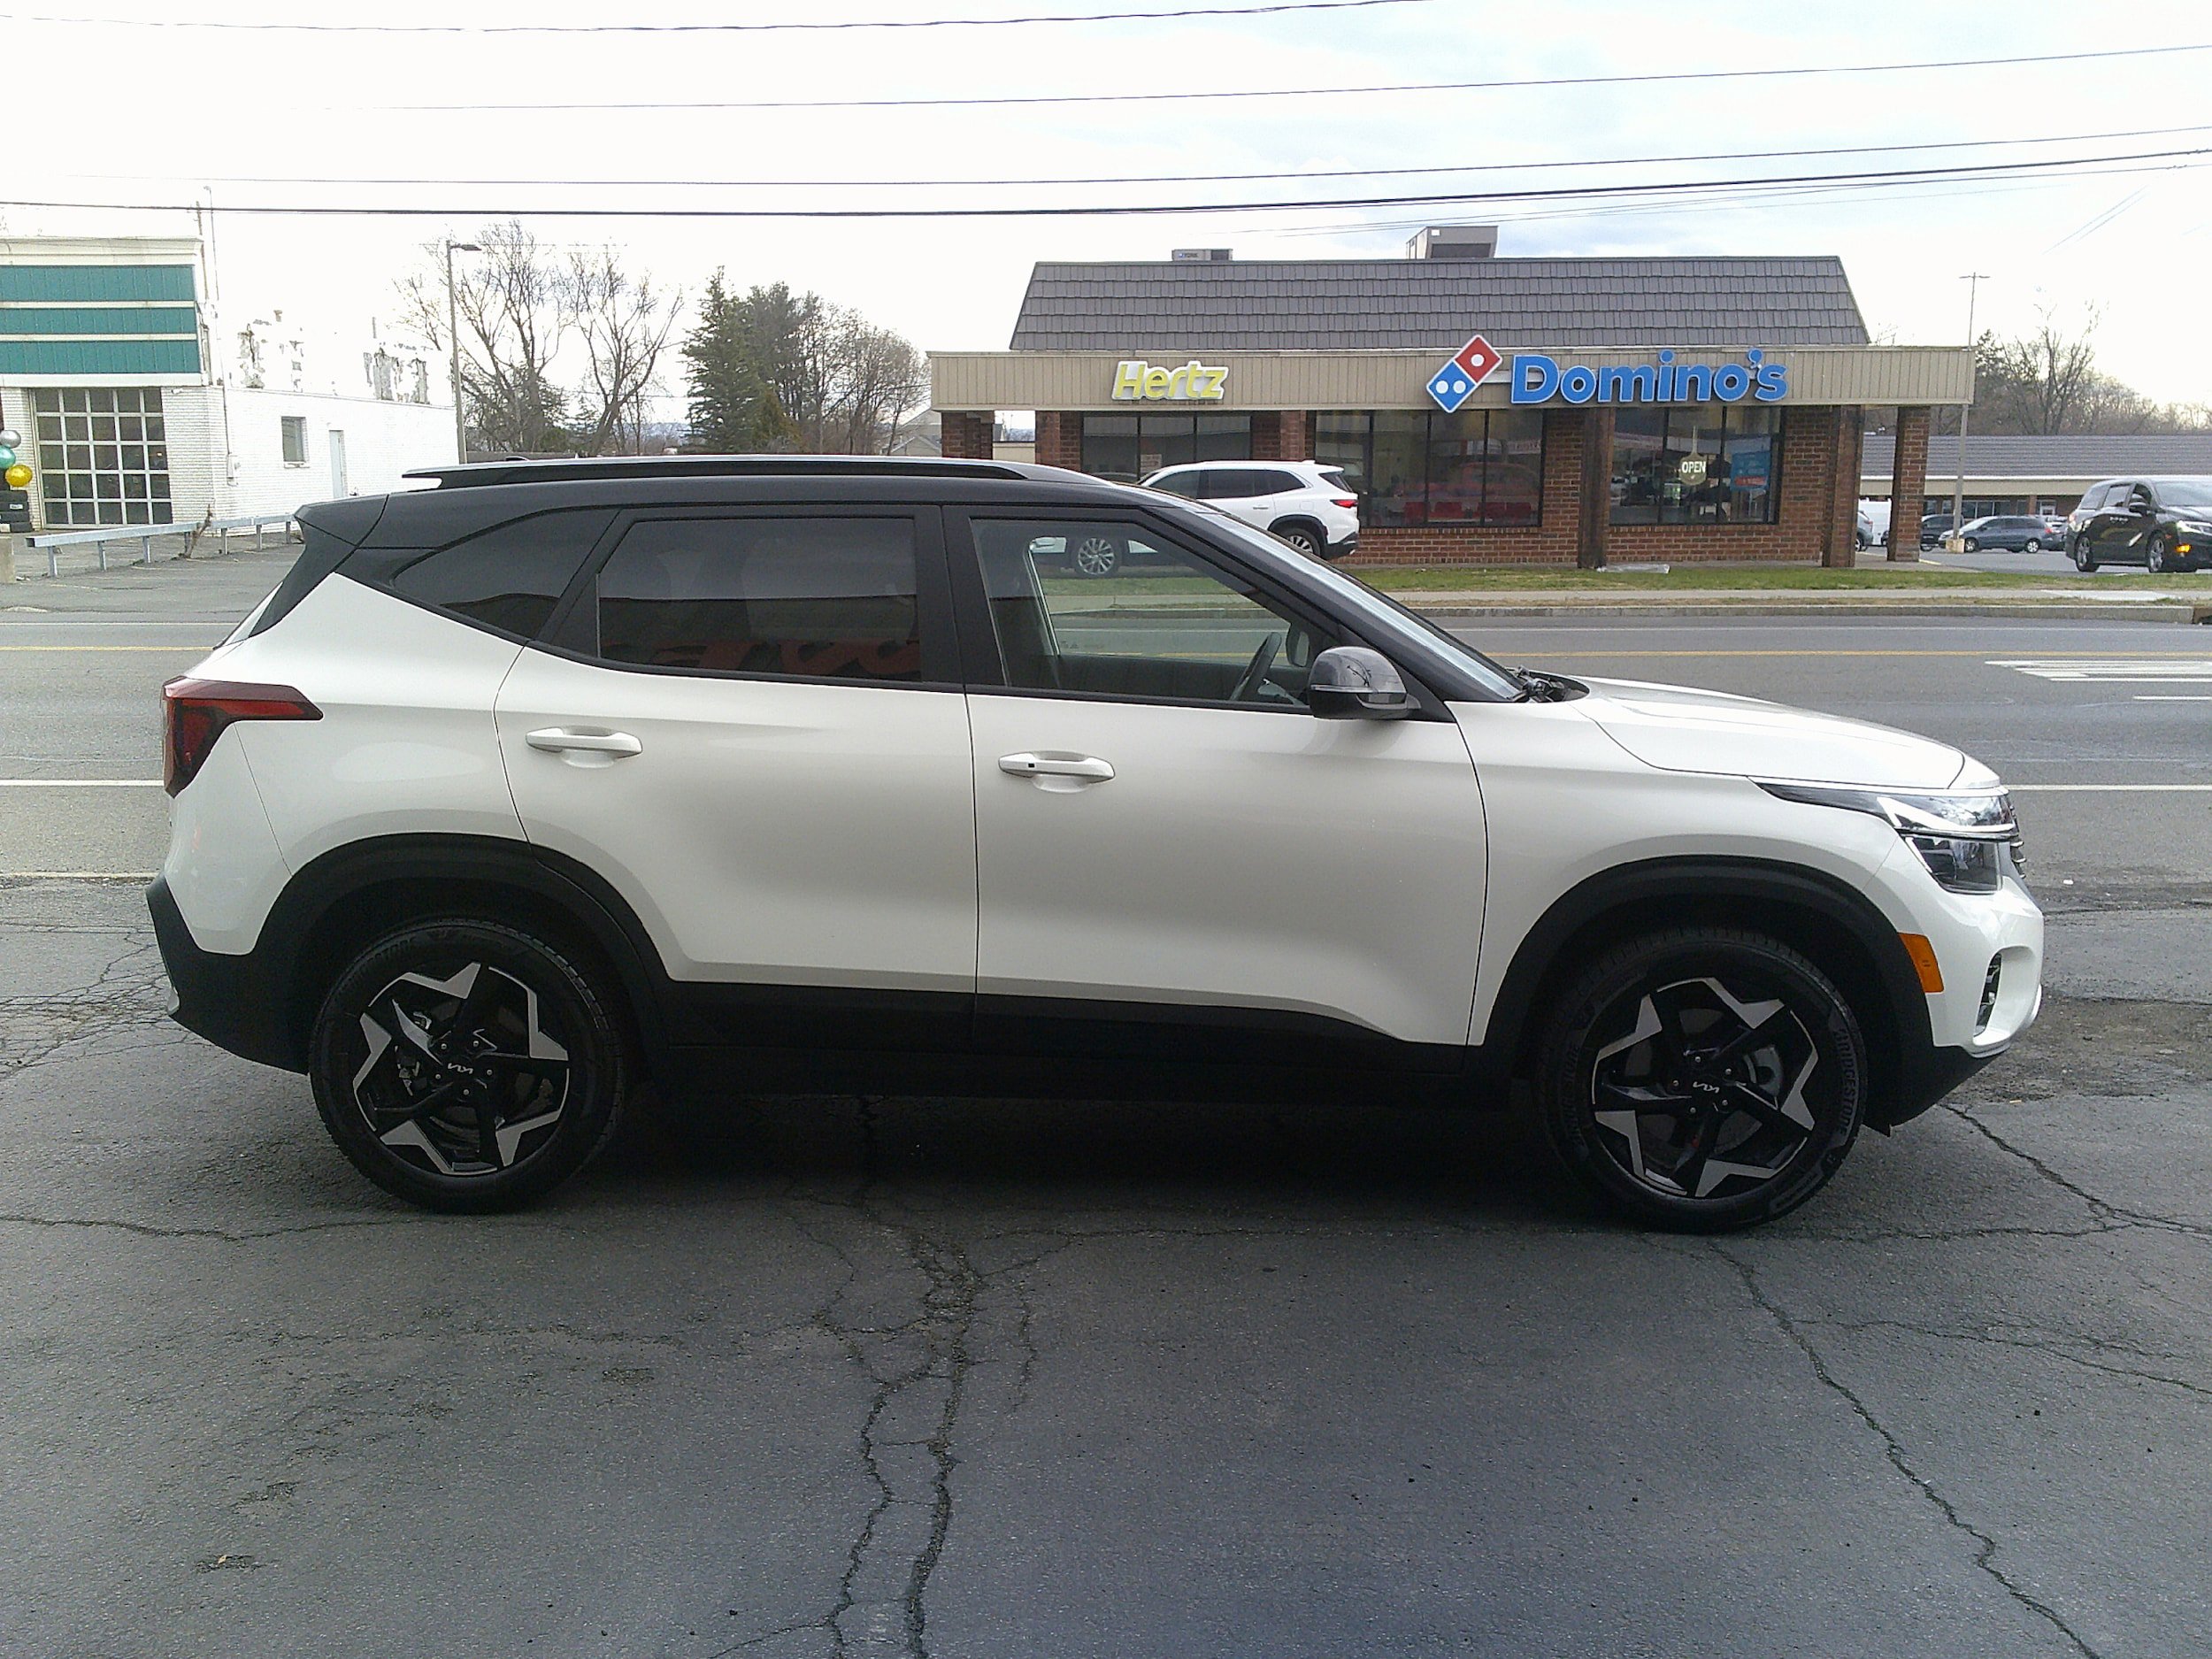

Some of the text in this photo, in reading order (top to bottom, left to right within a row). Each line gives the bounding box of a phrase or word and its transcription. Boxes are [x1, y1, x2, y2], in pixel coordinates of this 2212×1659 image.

[1114, 364, 1226, 398] Hertz
[1511, 349, 1788, 403] Domino's
[1682, 461, 1707, 473] OPEN
